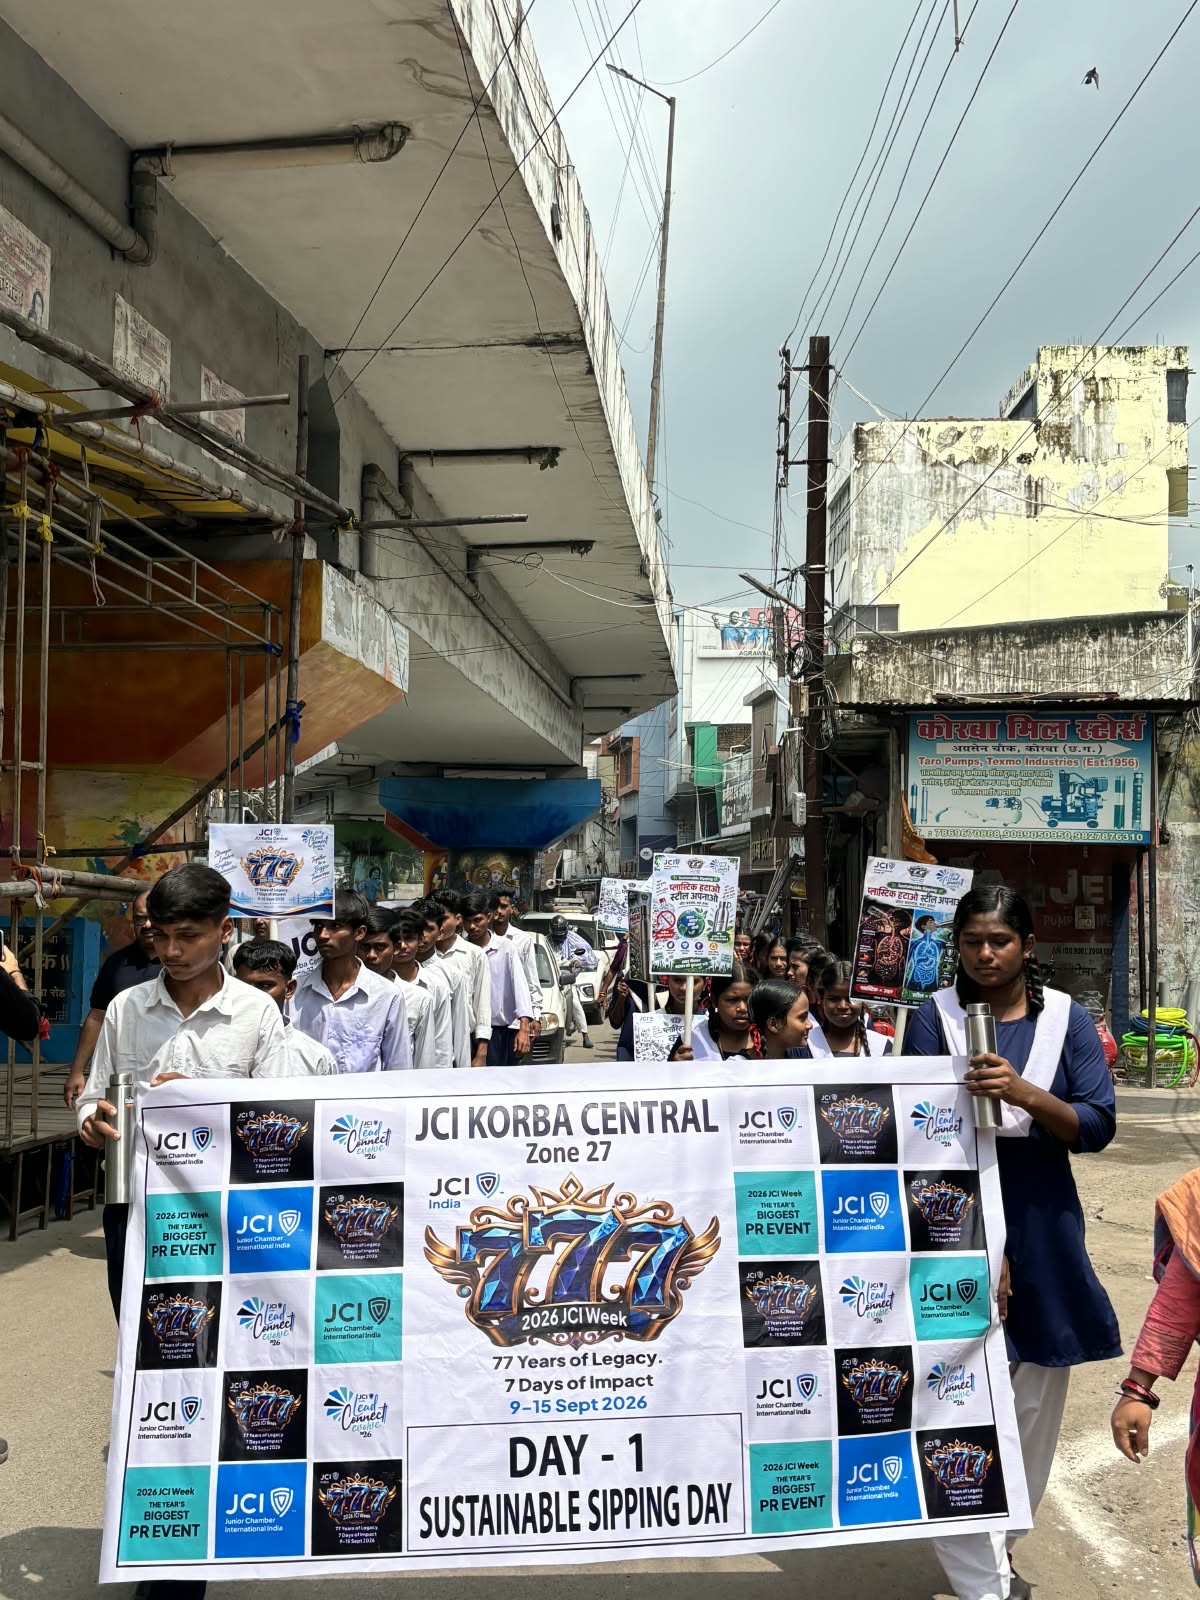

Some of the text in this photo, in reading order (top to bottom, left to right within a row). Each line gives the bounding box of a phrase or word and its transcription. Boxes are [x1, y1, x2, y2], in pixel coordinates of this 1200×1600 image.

[917, 713, 1146, 740] कोरबा मिल स्टोर्स
[952, 743, 1103, 754] अग्रसेन चौक, कोरबा (छ.ग.)
[919, 757, 1139, 768] Taro Pumps, Texmo Industries (Est.1956)
[669, 882, 720, 893] प्लास्टिक हटाओ
[868, 886, 896, 897] प्लास्टिक
[898, 892, 918, 902] हटाओ
[670, 892, 718, 902] स्टील अपनाओ
[415, 1099, 719, 1141] JCI KORBA CENTRAL
[739, 1112, 772, 1129] JCI
[358, 1121, 382, 1138] Lead
[155, 1133, 186, 1151] JCI
[346, 1129, 392, 1154] Connect
[526, 1141, 611, 1163] Zone 27
[429, 1177, 470, 1197] JCI
[748, 1189, 802, 1198] 2026 JCI Week
[429, 1198, 461, 1209] India
[833, 1197, 864, 1215] JCI
[156, 1212, 176, 1220] 2026
[190, 1210, 208, 1218] Week
[757, 1210, 799, 1220] BIGGEST
[182, 1222, 202, 1230] YEAR'S
[237, 1215, 272, 1234] JCI
[746, 1222, 811, 1236] PR EVENT
[163, 1231, 207, 1241] BIGGEST
[152, 1244, 216, 1258] PR EVENT
[866, 1282, 888, 1300] Lead
[919, 1283, 951, 1302] JCI
[264, 1304, 286, 1322] Lead
[325, 1303, 362, 1322] JCI
[857, 1291, 895, 1317] Connect
[253, 1311, 296, 1339] Connect
[522, 1308, 628, 1331] 2026 JCI Week
[492, 1351, 663, 1370] 77 Years of Legacy.
[505, 1374, 653, 1393] 7 Days of Impact
[756, 1379, 791, 1399] JCI
[140, 1402, 175, 1422] JCI
[353, 1394, 378, 1415] Lead
[556, 1398, 599, 1415] Sept
[602, 1396, 647, 1411] 2026
[341, 1404, 388, 1430] Connect
[509, 1433, 589, 1478] DAY
[628, 1433, 644, 1473] 1
[763, 1461, 819, 1472] 2026 JCI Week
[846, 1464, 878, 1484] JCI
[136, 1487, 195, 1496] 2026 JCI Week
[772, 1483, 815, 1495] BIGGEST
[226, 1493, 264, 1515] JCI
[419, 1482, 733, 1539] SUSTAINABLE SIPPING DAY
[760, 1495, 826, 1512] PR EVENT
[144, 1511, 190, 1520] BIGGEST
[129, 1523, 200, 1538] PR EVENT
